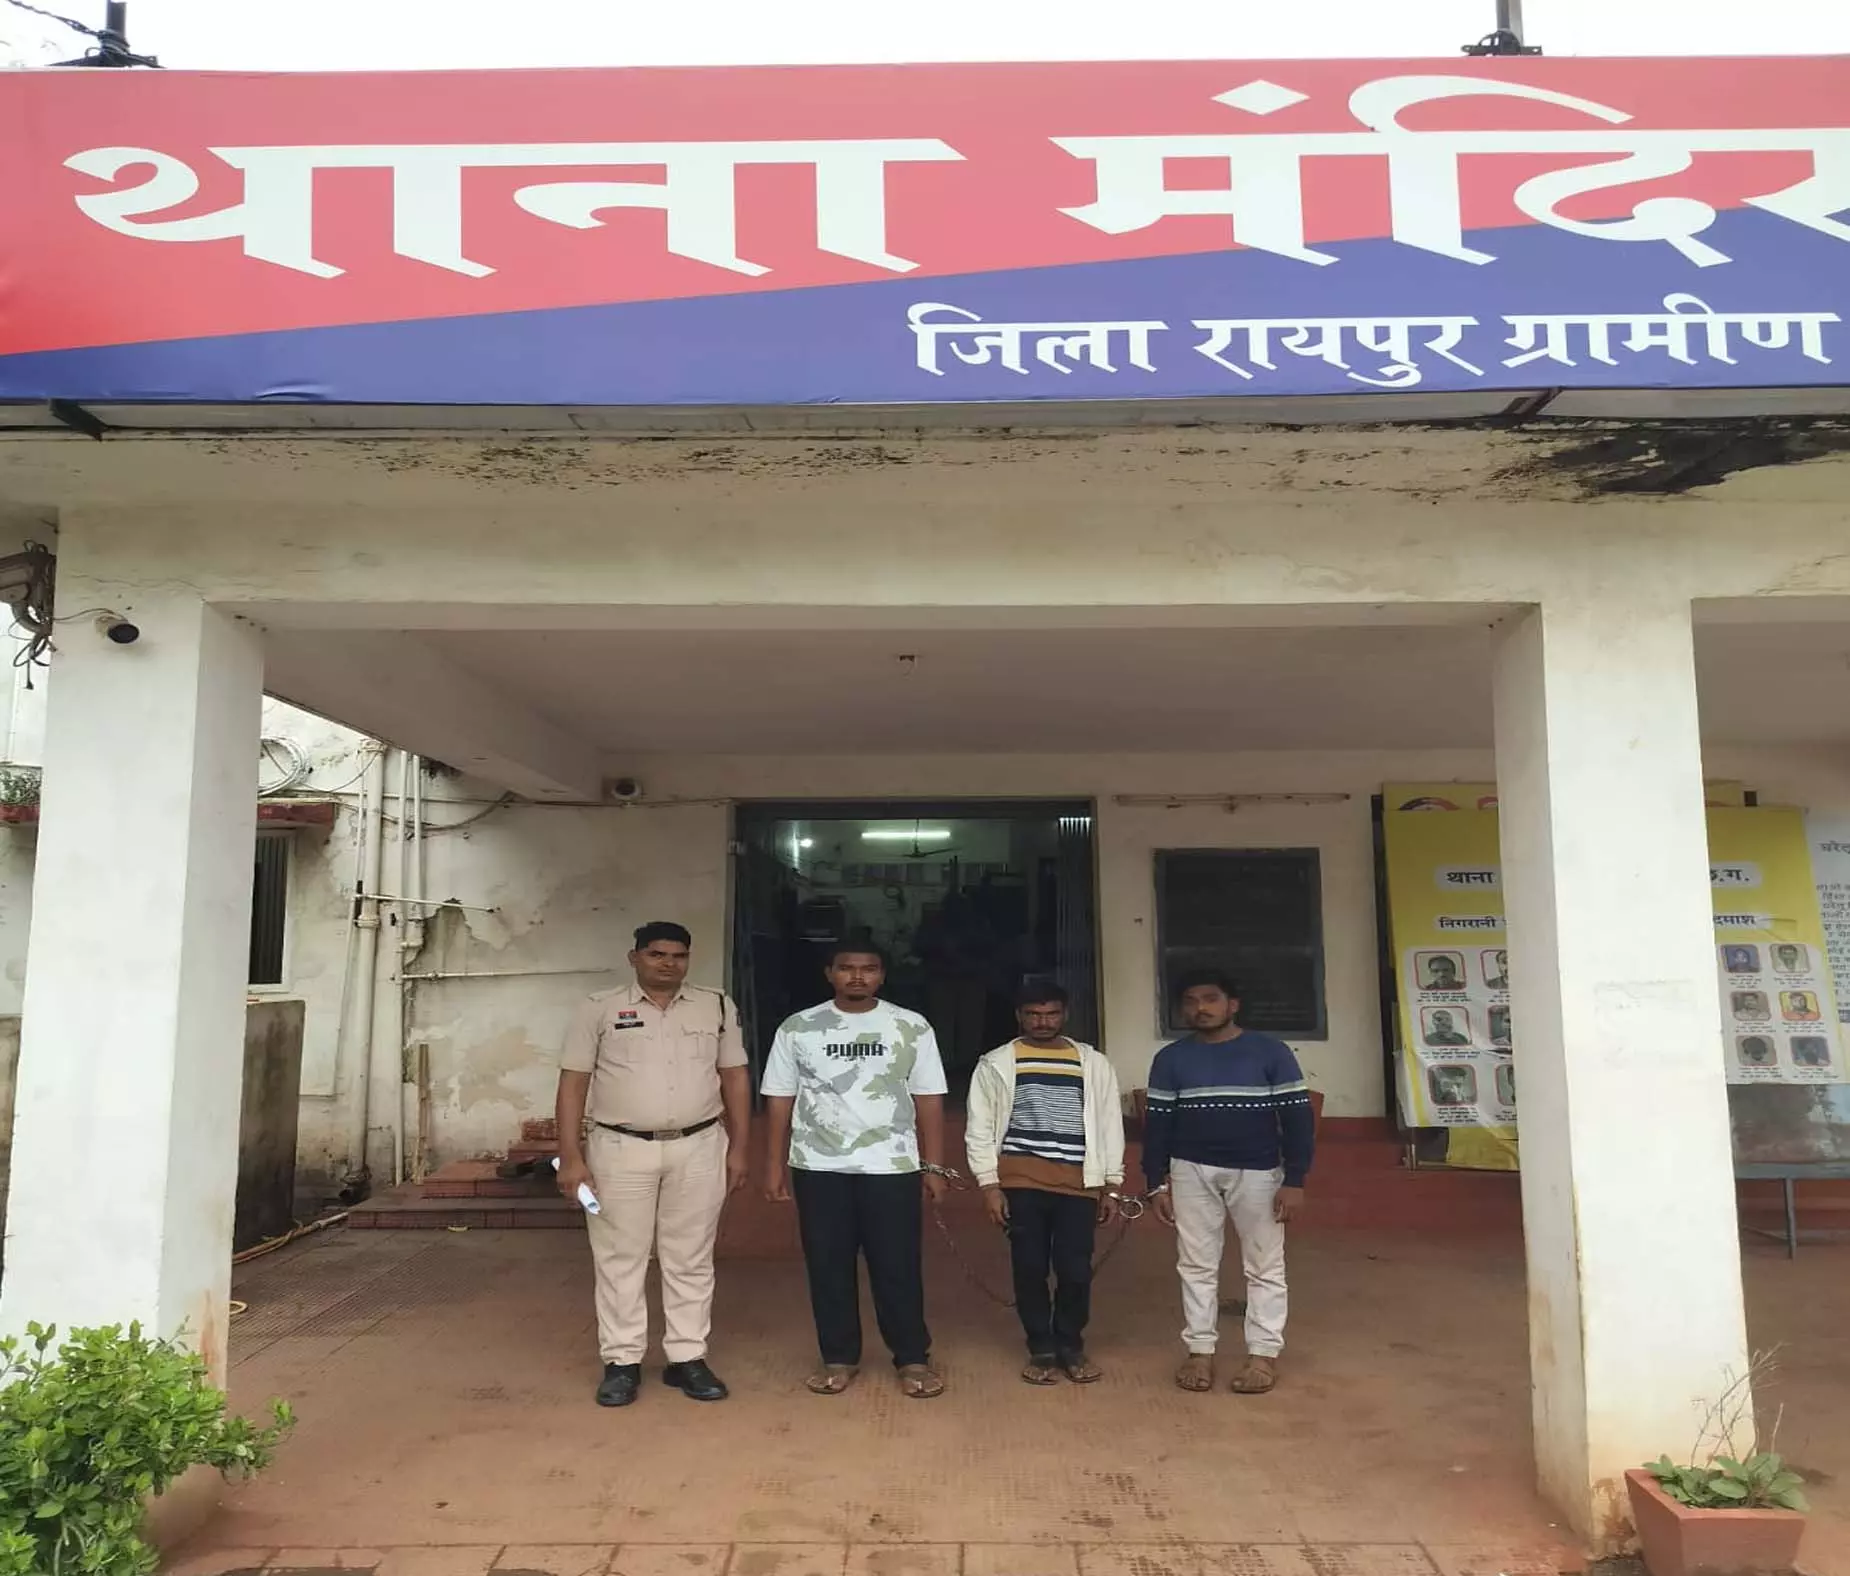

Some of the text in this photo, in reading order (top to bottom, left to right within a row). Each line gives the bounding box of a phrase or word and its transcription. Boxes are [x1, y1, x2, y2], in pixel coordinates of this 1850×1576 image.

[61, 75, 1850, 278] थाना मंदिर
[905, 292, 1842, 388] जिला रायपुर ग्रामीण
[1446, 871, 1494, 884] थाना
[1439, 915, 1497, 928] निगरानी
[1713, 914, 1757, 925] दमाश
[826, 1043, 884, 1057] PUMA
